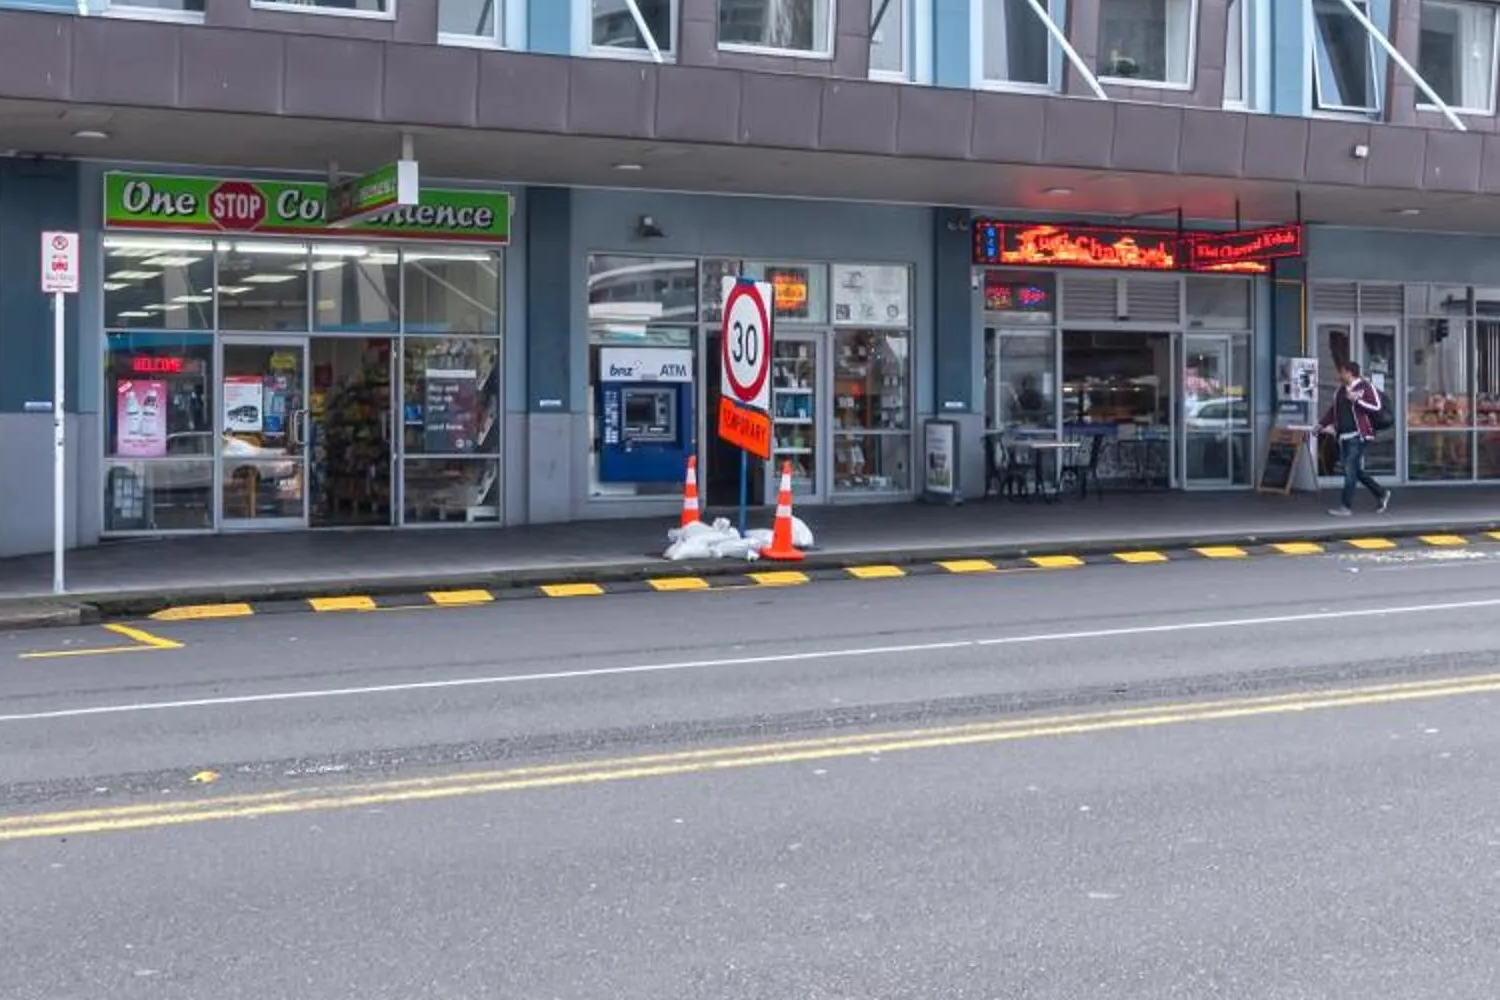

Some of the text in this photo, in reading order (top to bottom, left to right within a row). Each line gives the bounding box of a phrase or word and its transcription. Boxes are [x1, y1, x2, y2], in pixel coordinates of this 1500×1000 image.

[122, 181, 196, 216] One
[213, 194, 261, 220] STOP
[733, 321, 758, 367] 30
[609, 363, 687, 377] bnz ATM
